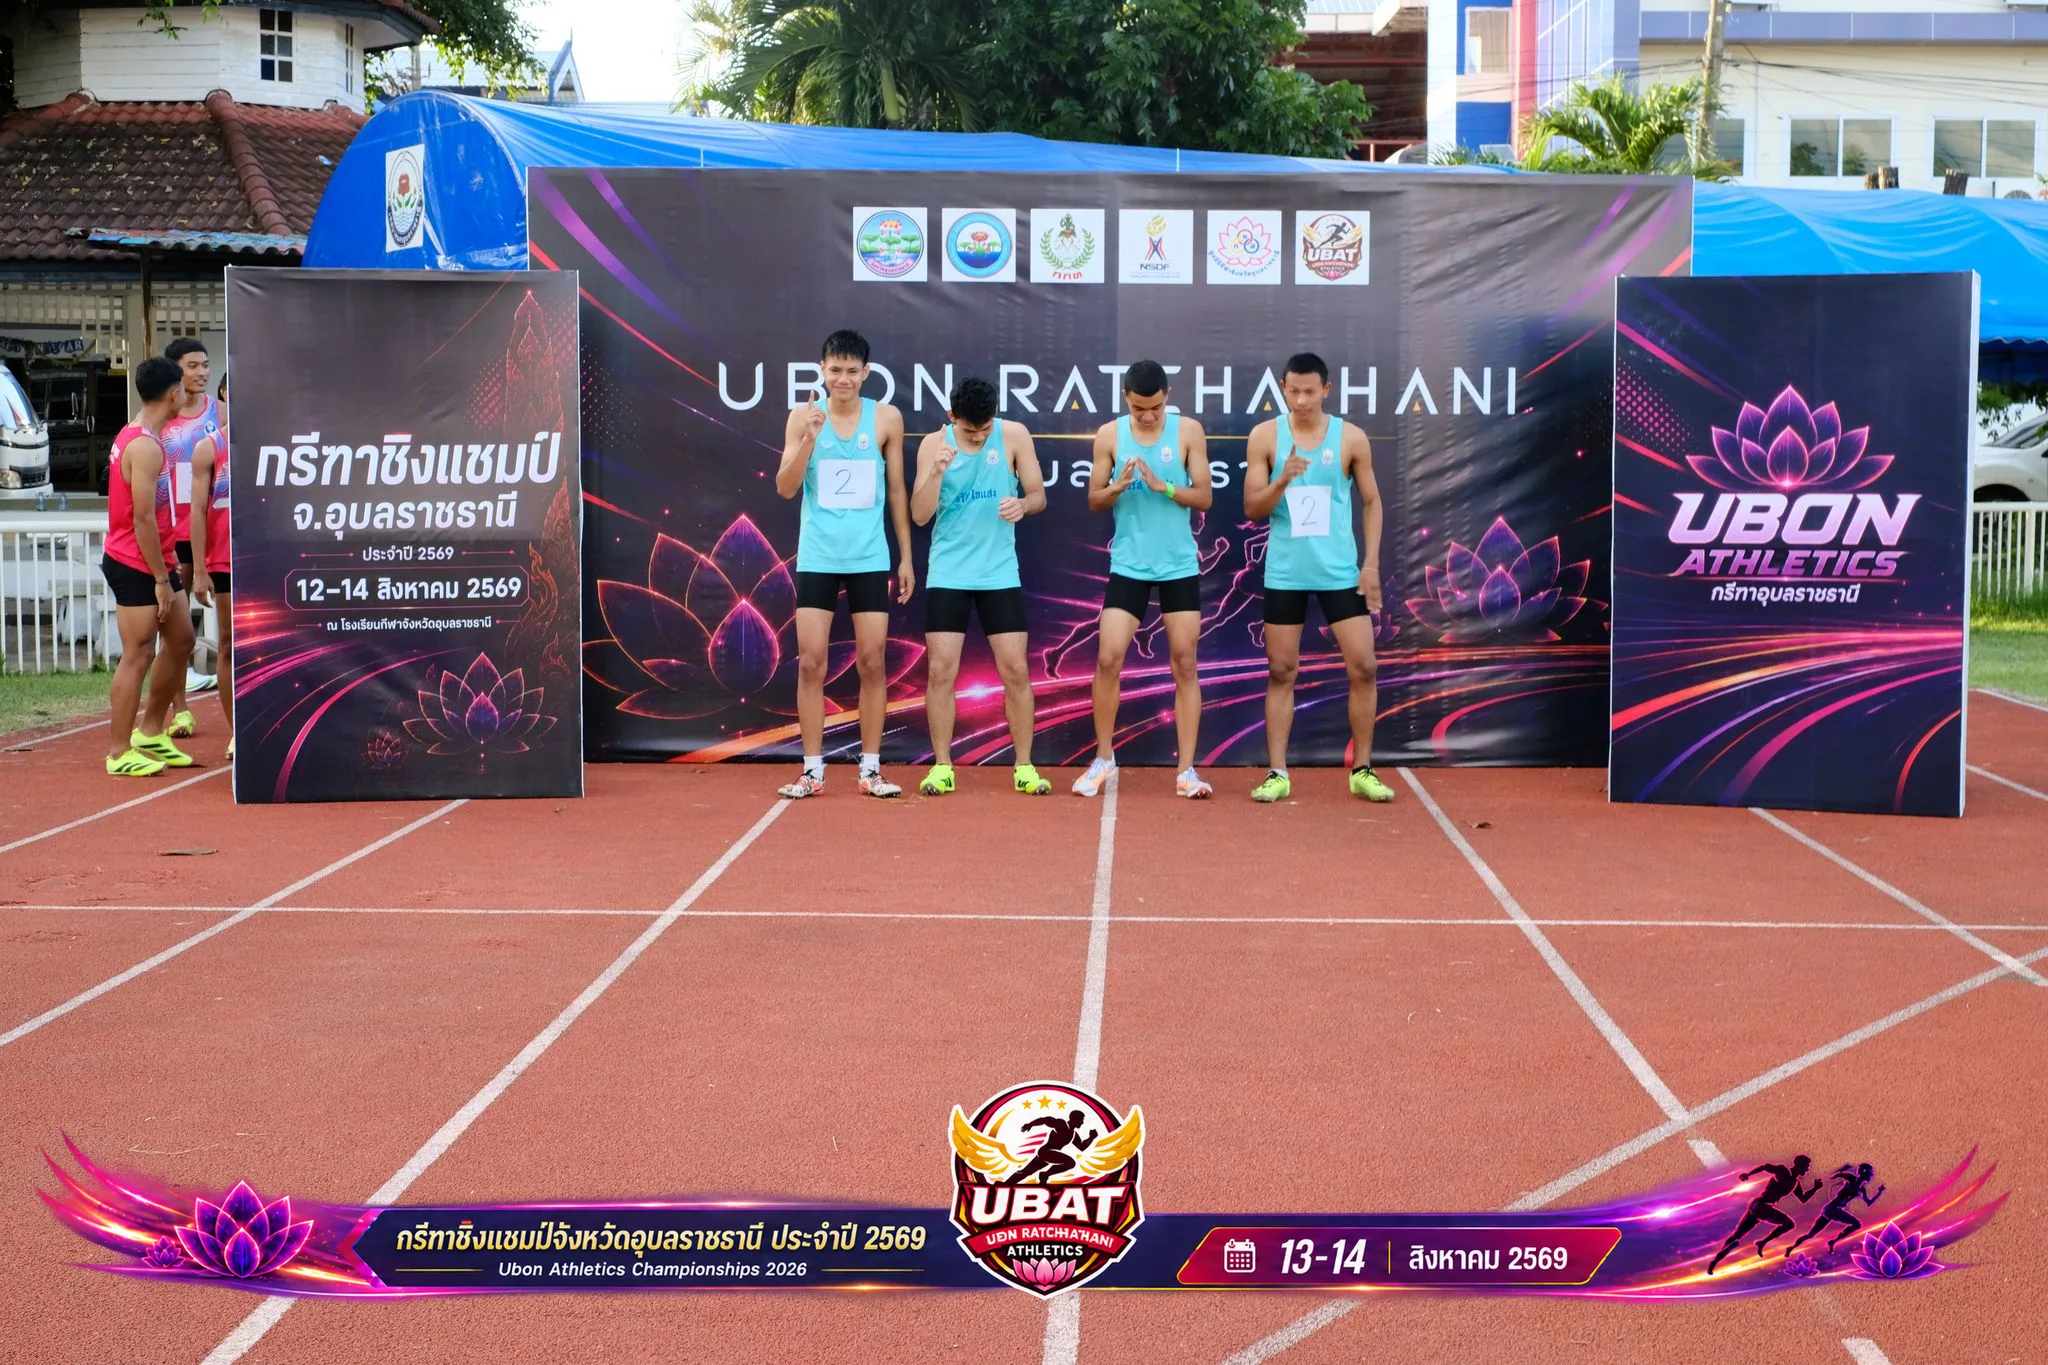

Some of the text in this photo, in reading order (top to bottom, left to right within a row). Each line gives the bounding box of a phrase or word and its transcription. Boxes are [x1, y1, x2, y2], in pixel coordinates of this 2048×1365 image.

[1139, 263, 1170, 271] NSDF
[1307, 248, 1358, 262] UBAT
[999, 364, 1516, 415] RATHAHANI
[255, 431, 562, 486] กรีฑาชิงแชมป์
[834, 468, 857, 495] 2
[293, 490, 519, 541] จ.อุบลราชธานี
[1300, 495, 1318, 526] 2
[1668, 493, 1923, 546] UBON
[362, 545, 455, 561] ประจำปี 2569
[1668, 549, 1912, 577] ATHLETICS
[377, 577, 459, 600] สิงหาคม
[466, 577, 522, 598] 2569
[1710, 582, 1861, 606] กรีฑาอุบลราชธานี
[326, 616, 492, 632] ณ โรงเรียนกีฬาจังหวัดอุบลราชธานี
